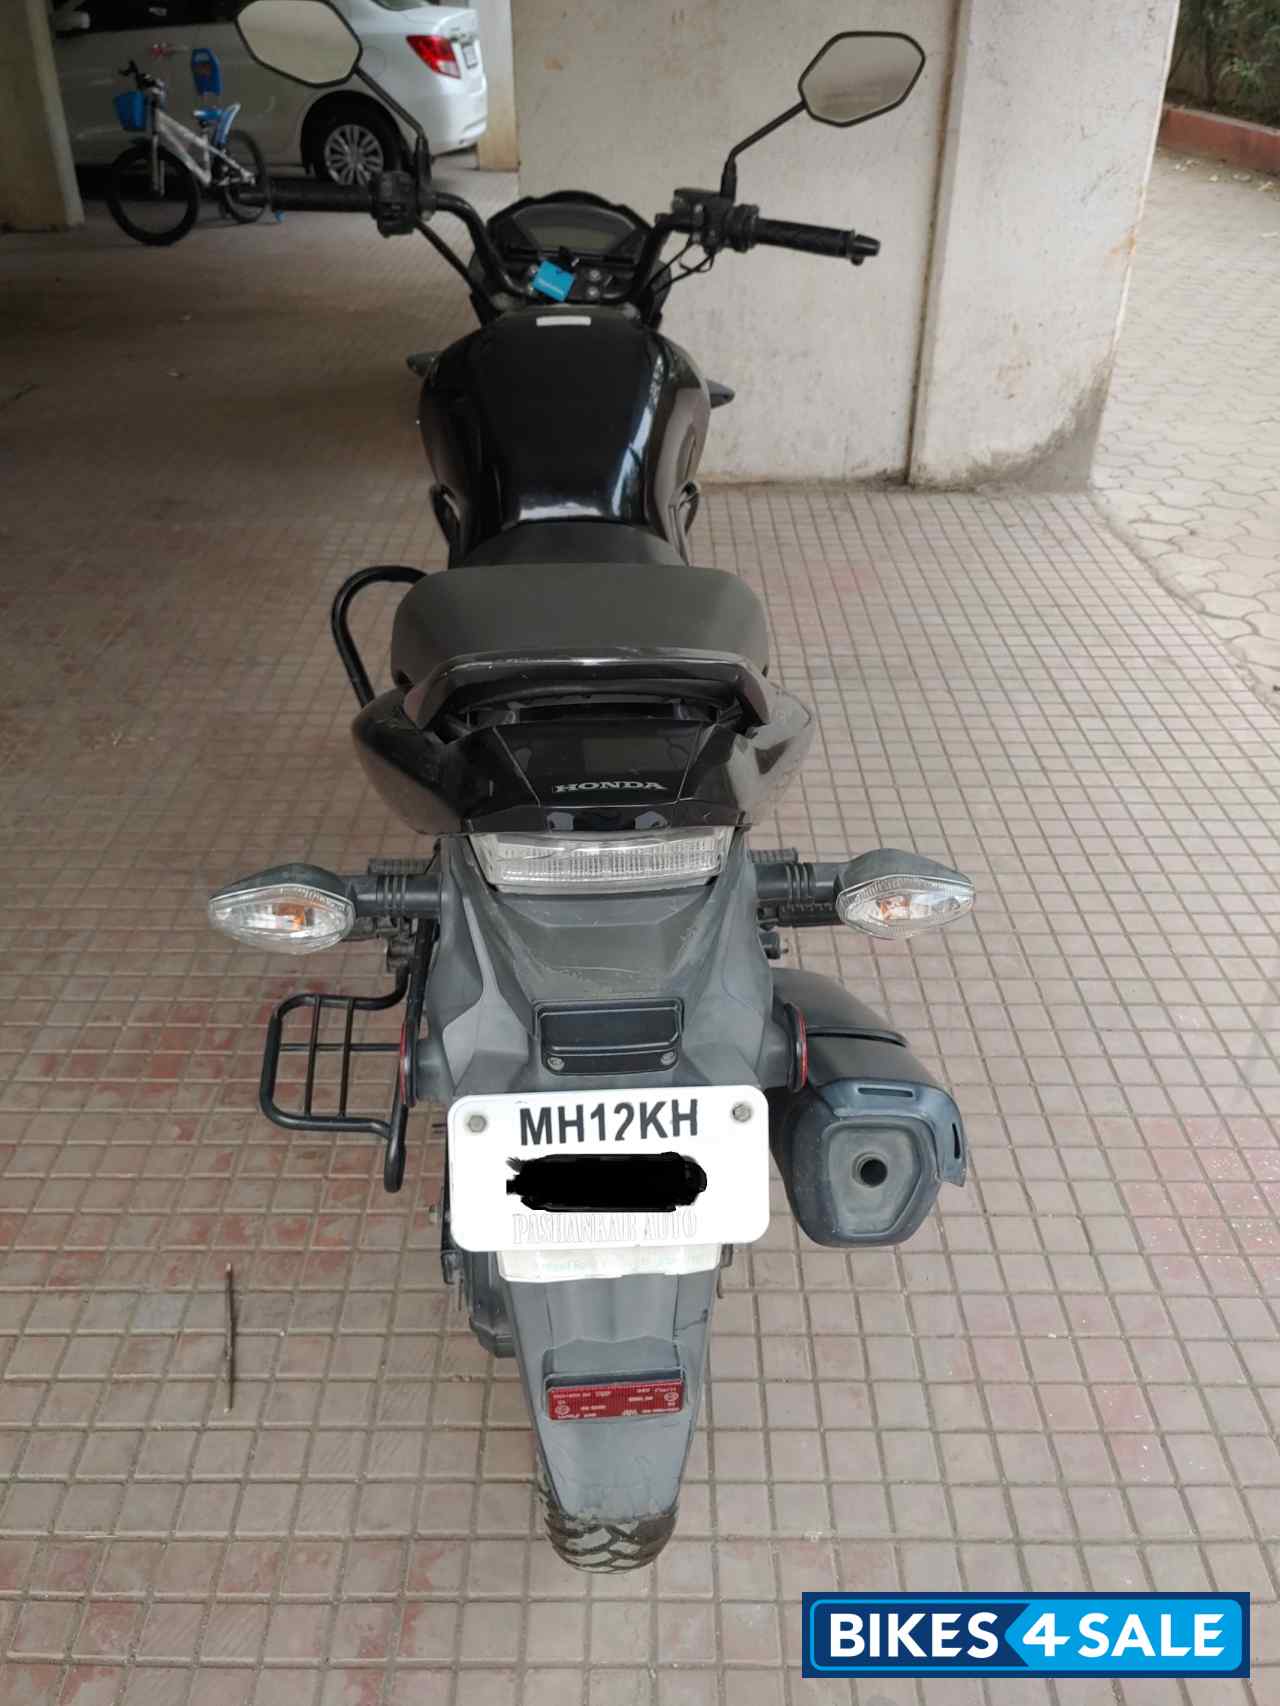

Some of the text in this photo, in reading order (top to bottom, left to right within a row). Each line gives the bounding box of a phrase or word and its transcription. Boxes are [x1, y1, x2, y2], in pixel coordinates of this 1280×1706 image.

[554, 780, 667, 793] HONDA
[519, 1098, 698, 1146] MH12KH
[643, 1207, 697, 1240] AUTO
